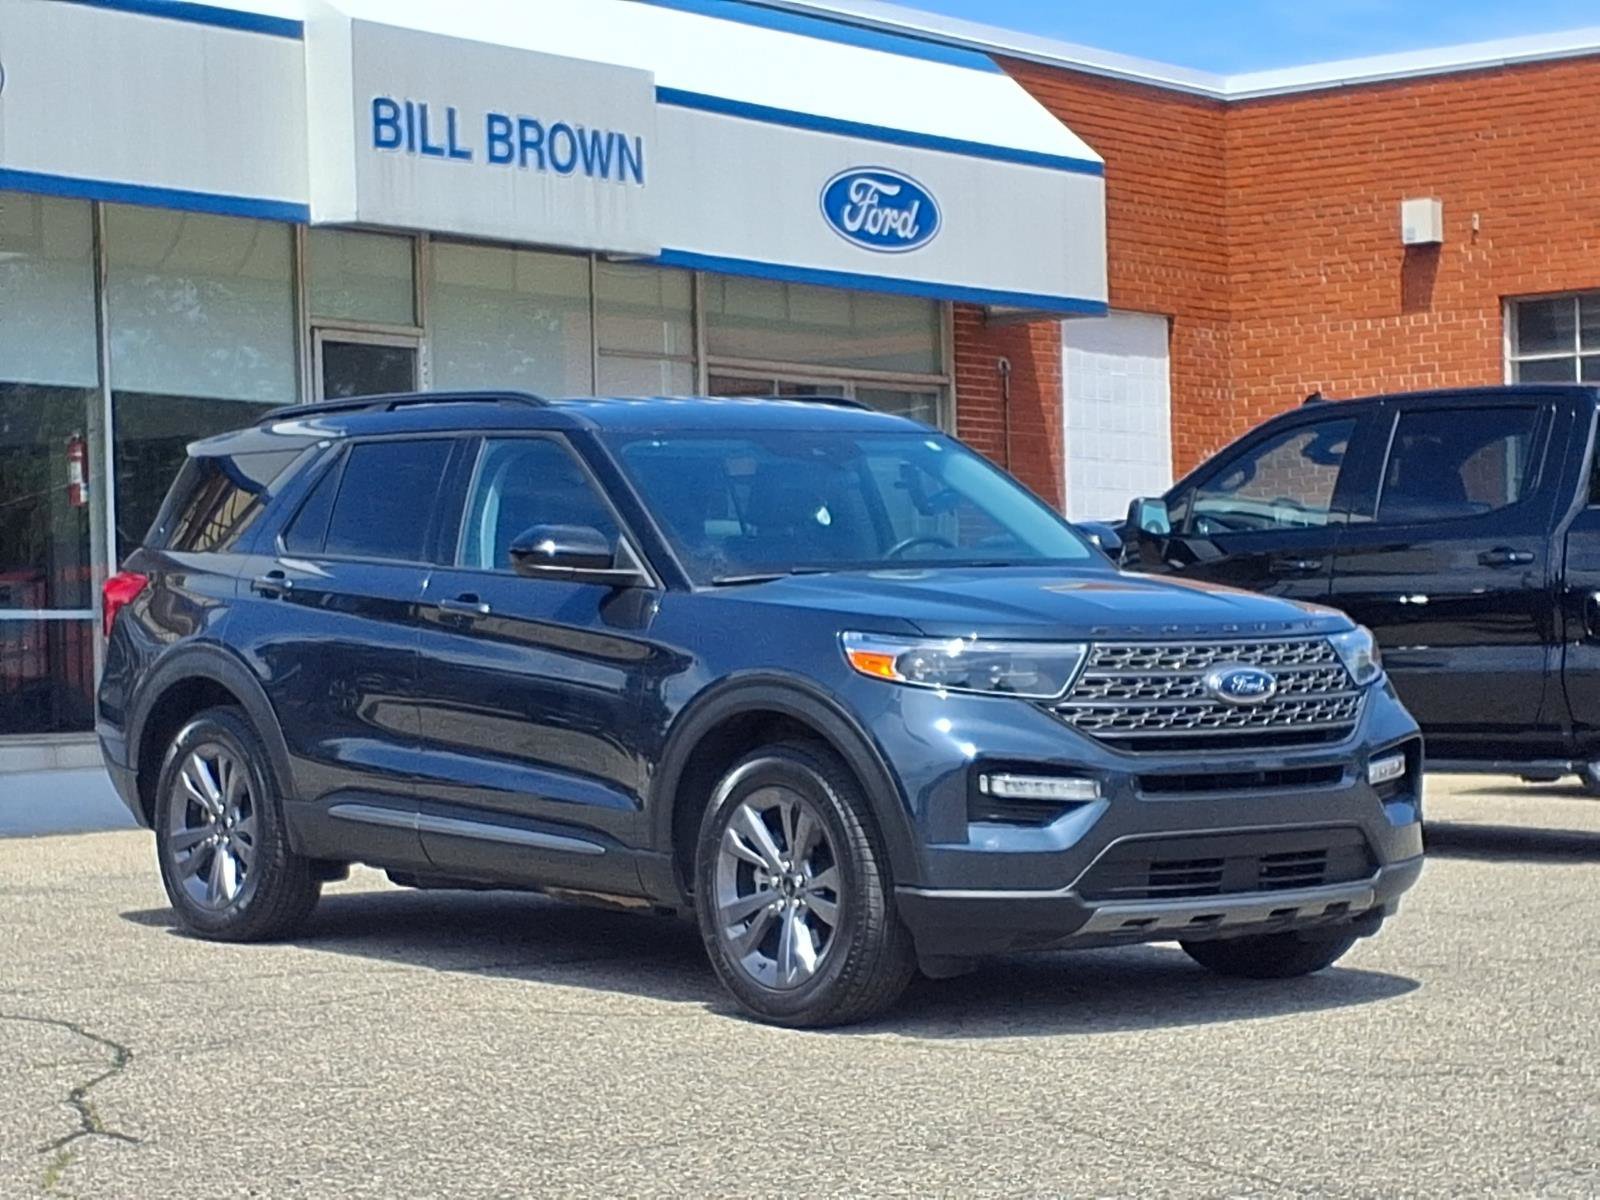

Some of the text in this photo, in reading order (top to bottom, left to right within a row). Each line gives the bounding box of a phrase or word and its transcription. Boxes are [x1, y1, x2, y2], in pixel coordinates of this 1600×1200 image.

[372, 97, 643, 184] BILL BROWN
[843, 178, 920, 239] Ford
